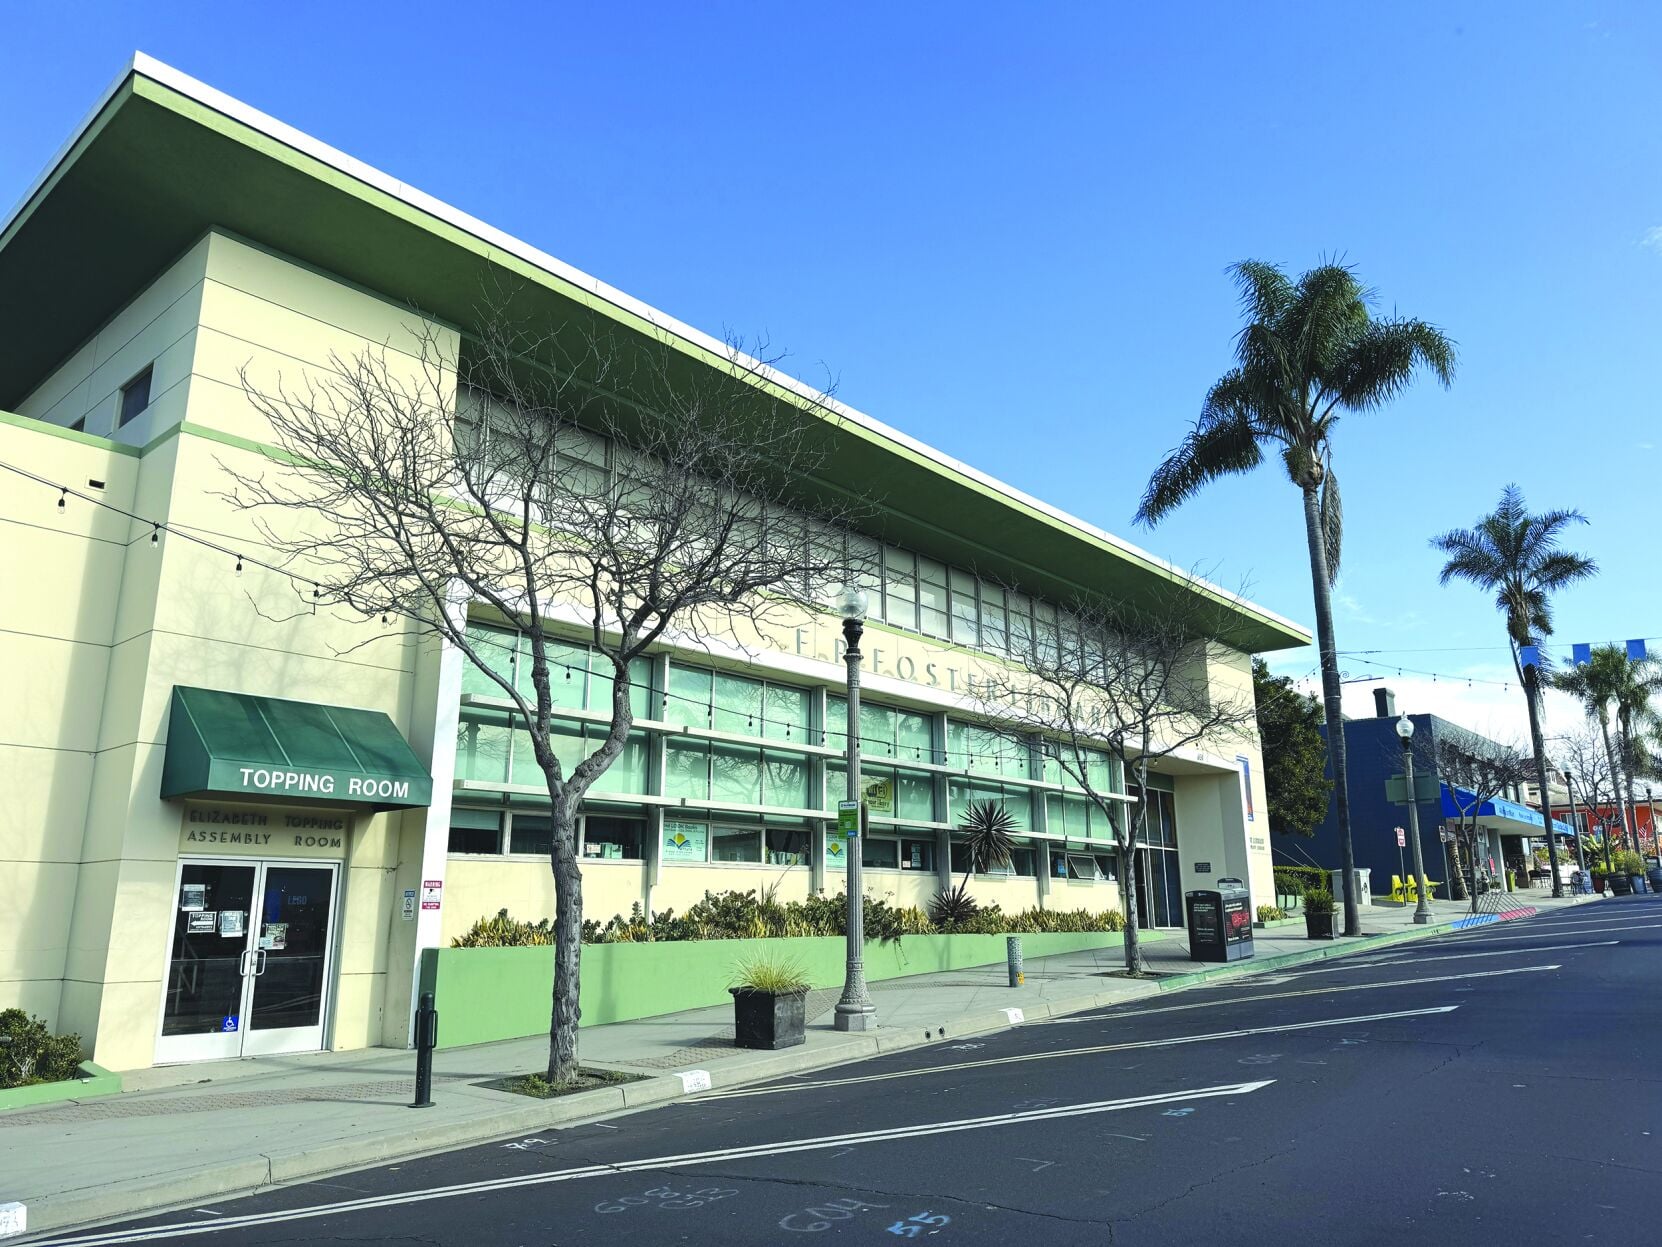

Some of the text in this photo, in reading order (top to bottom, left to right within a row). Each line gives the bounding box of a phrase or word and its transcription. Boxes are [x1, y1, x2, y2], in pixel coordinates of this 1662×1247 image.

[239, 768, 409, 799] TOPPING ROOM
[189, 809, 343, 831] ELIZABETH TOPPING
[187, 830, 341, 848] ASSEMBLY ROOM
